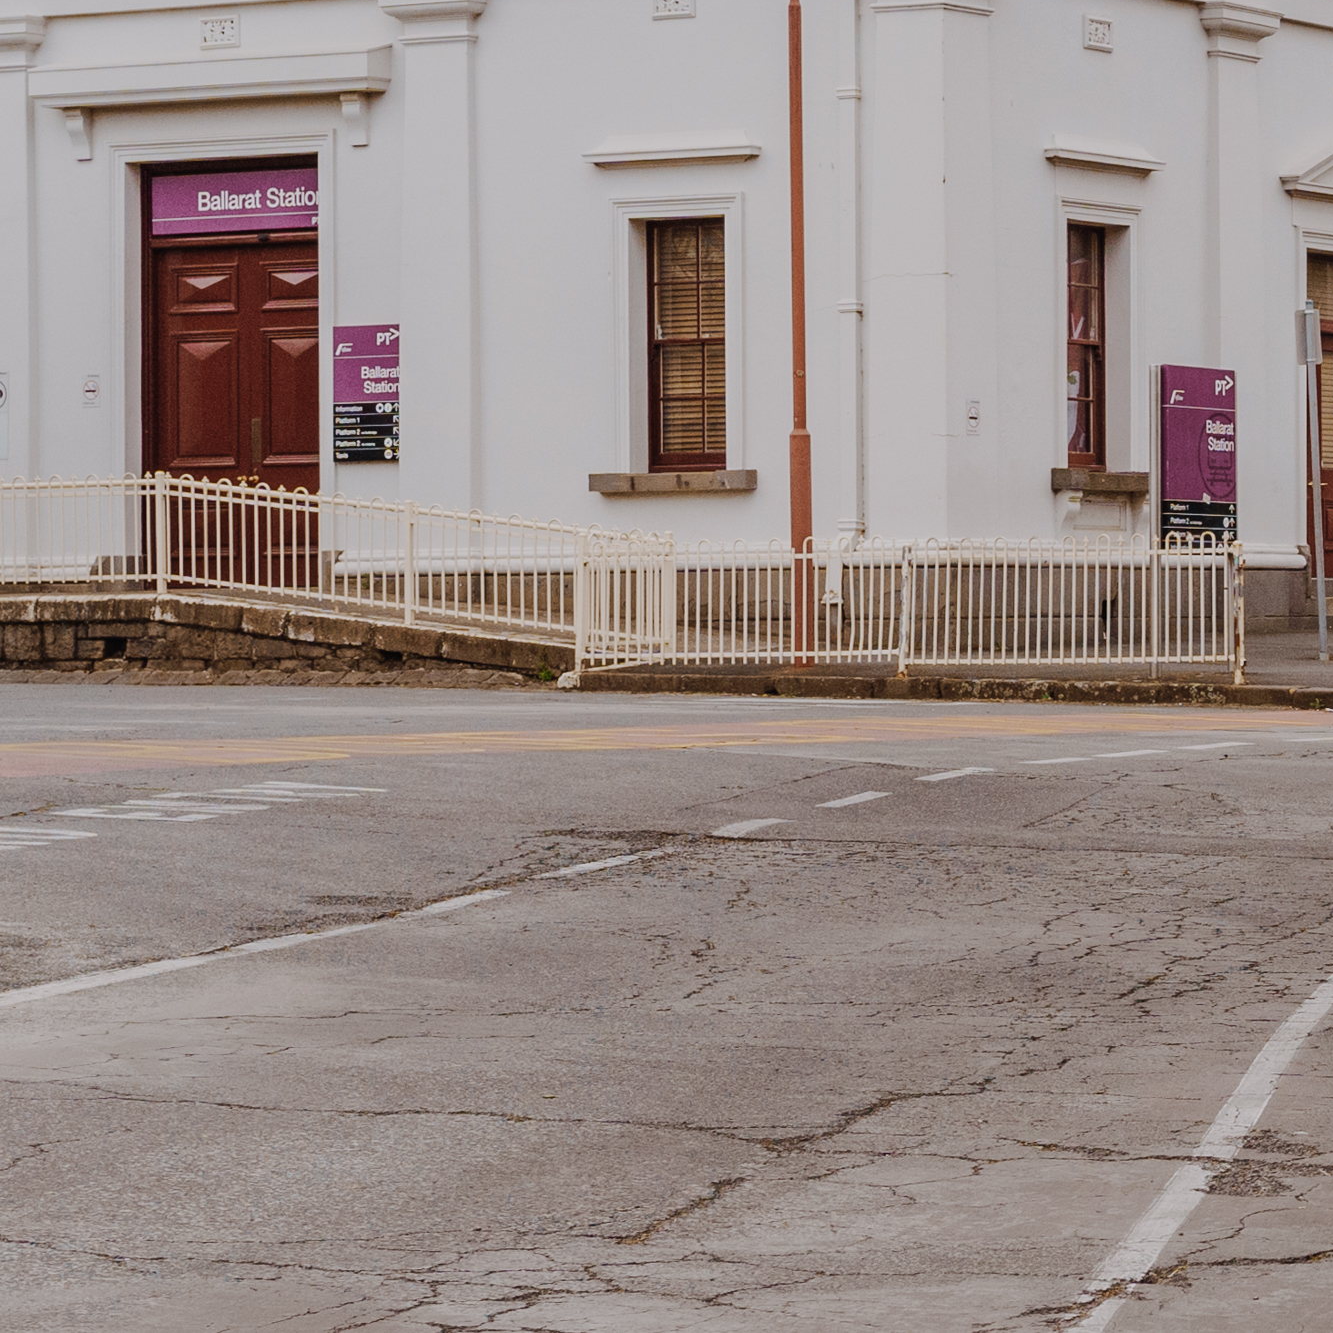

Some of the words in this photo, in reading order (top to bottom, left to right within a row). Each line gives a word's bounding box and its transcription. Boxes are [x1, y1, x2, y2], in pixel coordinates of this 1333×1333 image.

[197, 190, 262, 212] Ballarat
[361, 365, 400, 379] Ballarat
[363, 380, 400, 394] Station
[1206, 419, 1235, 436] Ballarat
[1207, 436, 1235, 452] Station
